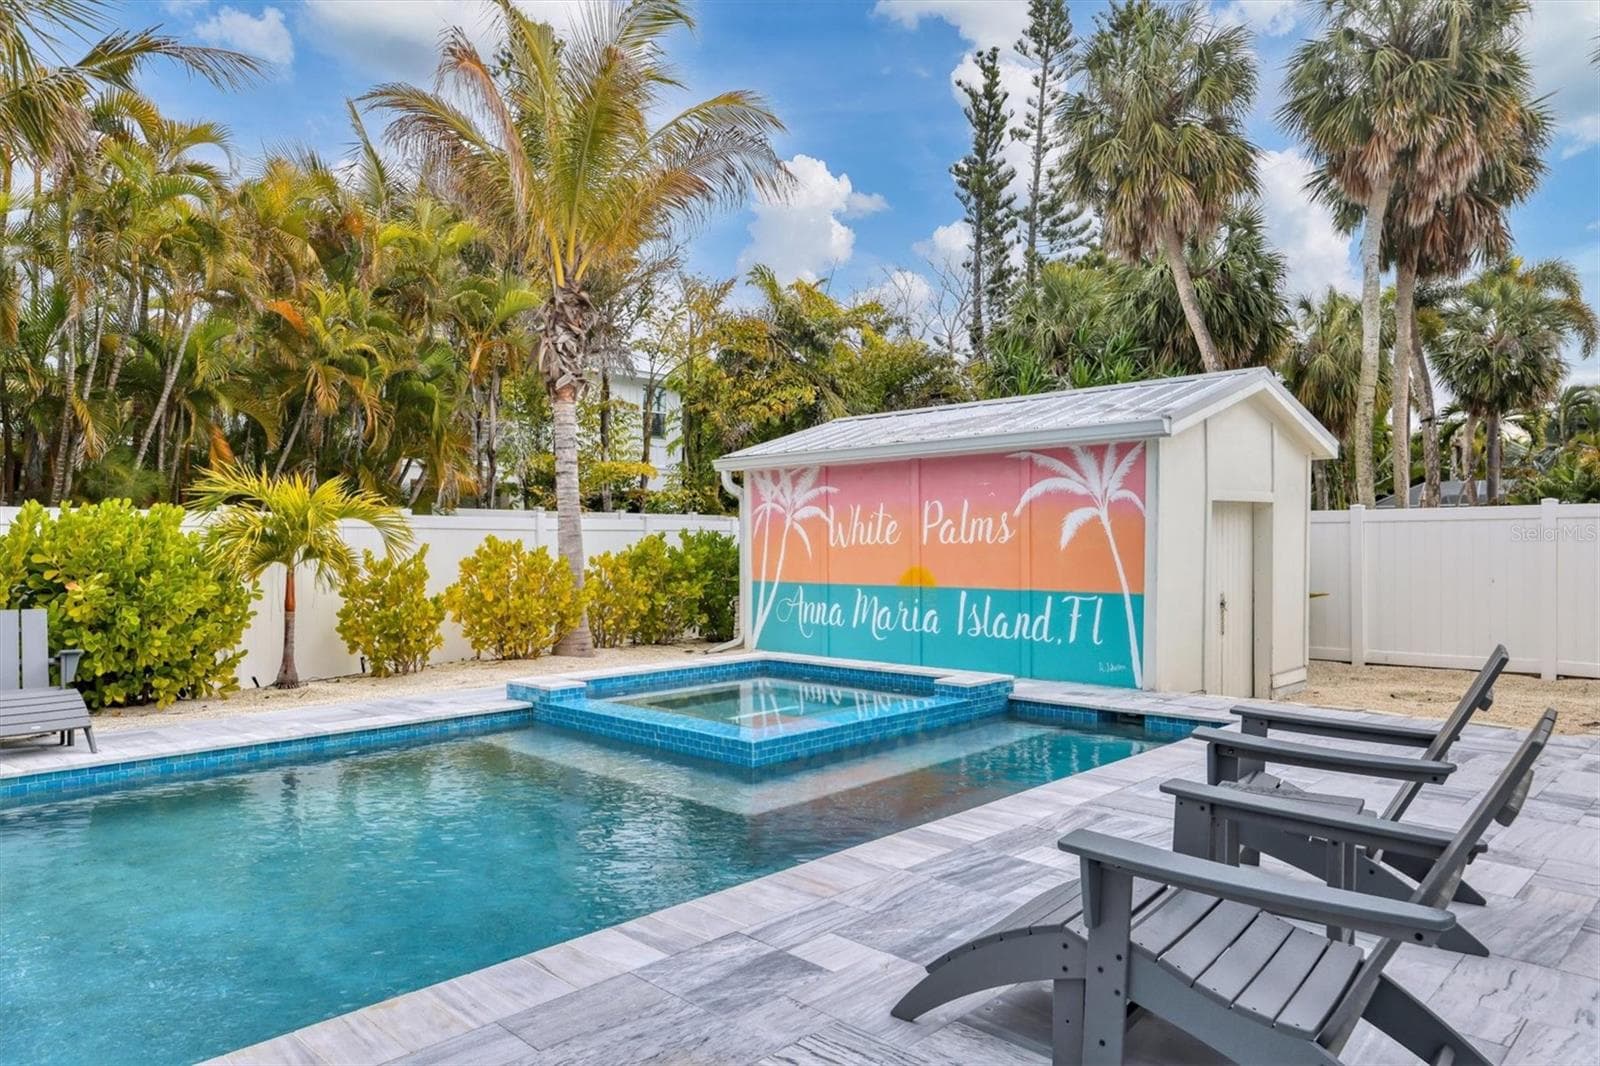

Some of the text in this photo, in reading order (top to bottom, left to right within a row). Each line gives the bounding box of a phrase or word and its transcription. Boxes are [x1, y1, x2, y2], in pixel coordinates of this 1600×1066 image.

[828, 499, 1016, 548] White Palms
[776, 586, 845, 639] Anna
[852, 588, 941, 641] Maria
